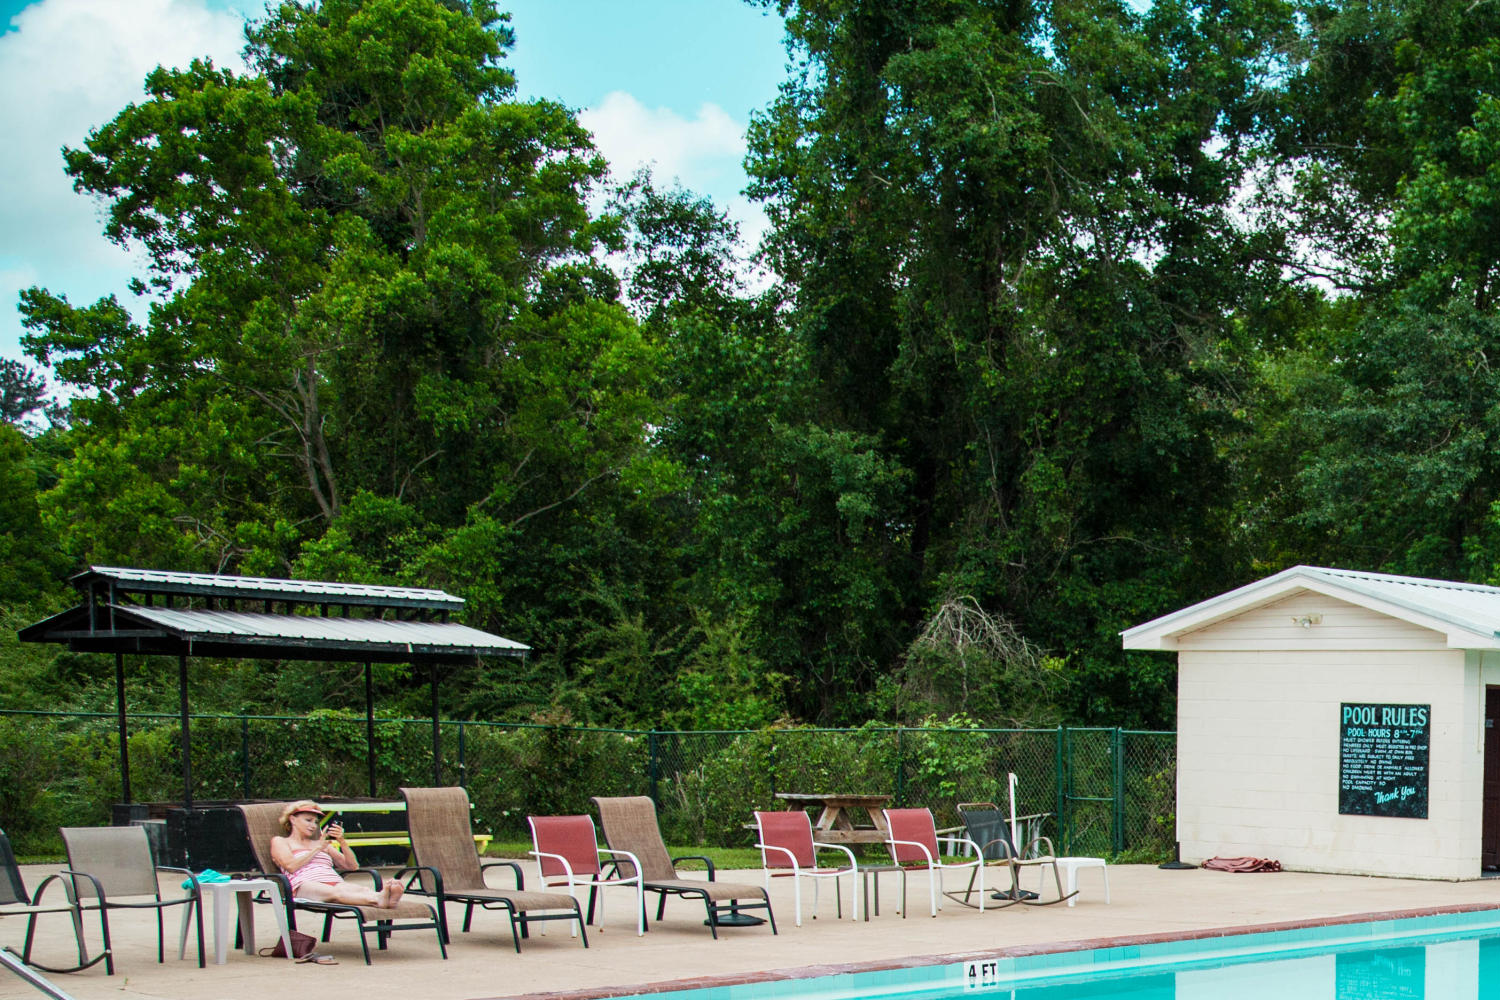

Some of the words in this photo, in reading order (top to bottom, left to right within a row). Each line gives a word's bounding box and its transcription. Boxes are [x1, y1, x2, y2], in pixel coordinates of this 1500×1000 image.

[1343, 706, 1378, 725] POOL
[1382, 707, 1427, 727] RULES
[1347, 727, 1365, 737] POOL
[1368, 728, 1391, 738] HOURS
[1374, 787, 1399, 804] Thank
[1401, 786, 1416, 800] You
[968, 964, 977, 978] 4
[982, 962, 997, 977] FT
